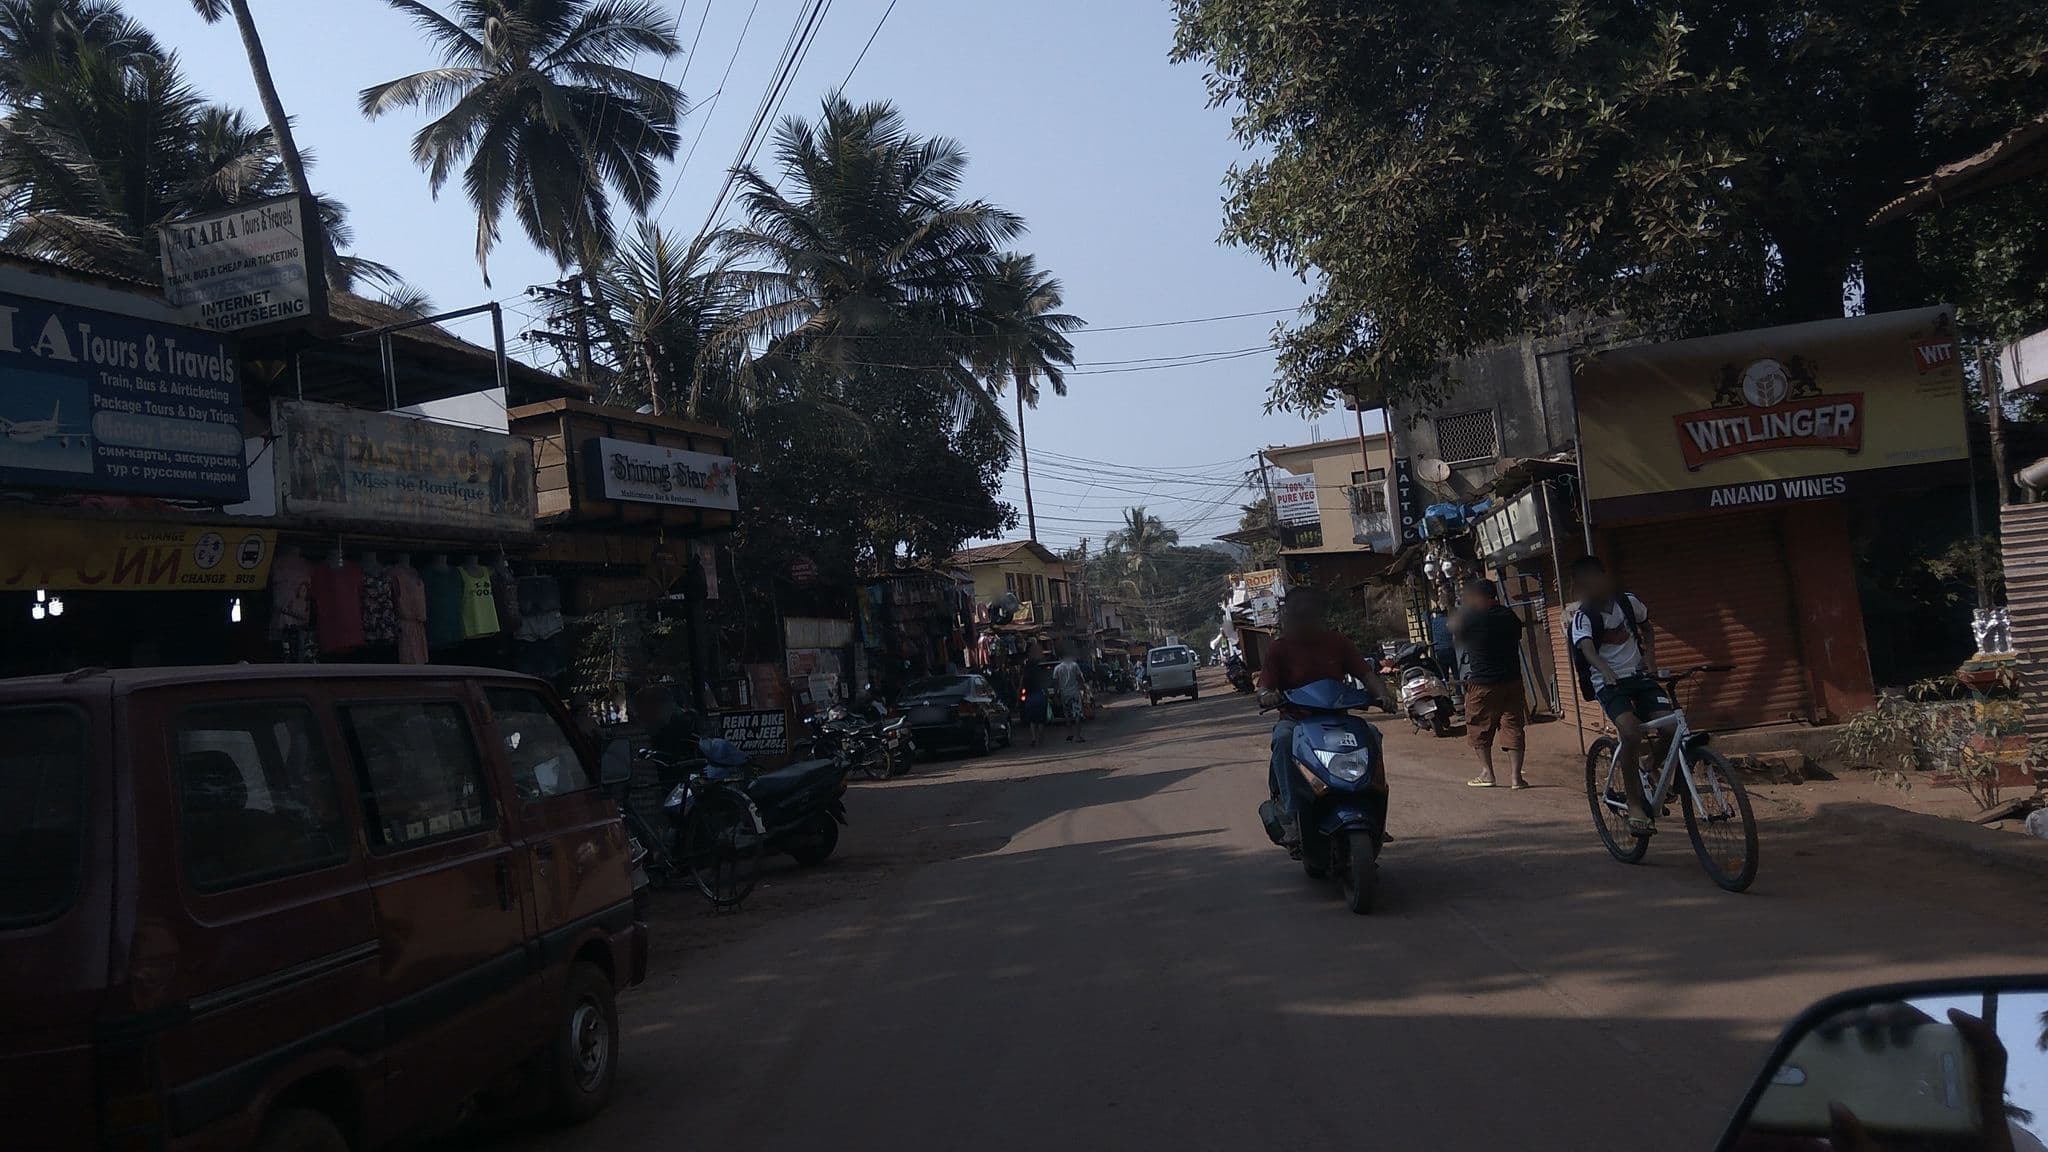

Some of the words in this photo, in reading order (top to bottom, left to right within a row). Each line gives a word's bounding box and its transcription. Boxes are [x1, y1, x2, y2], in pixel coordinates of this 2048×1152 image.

[184, 218, 237, 249] TAHA
[241, 214, 261, 236] Tours
[267, 207, 293, 229] Travels
[193, 270, 209, 281] BUS
[210, 267, 216, 277] &
[217, 262, 242, 274] CHEAP
[244, 257, 258, 268] AIR
[258, 248, 299, 265] TICKETING
[202, 290, 271, 316] INTERNET
[206, 299, 304, 329] SIGHTSEEING
[78, 322, 139, 369] Tours
[144, 334, 161, 372] &
[165, 338, 235, 384] Travels
[1918, 343, 1953, 364] WIT
[100, 372, 133, 391] Train,
[136, 377, 157, 391] Bus
[159, 380, 168, 393] &
[171, 381, 229, 404] Airticketing
[93, 393, 141, 414] Package
[144, 400, 176, 416] Tours
[178, 403, 186, 417] &
[189, 405, 208, 421] Day
[1684, 403, 1856, 454] WITLINGER
[97, 446, 172, 464] сим-карты,
[106, 463, 128, 477] тур
[143, 466, 198, 483] русским
[610, 453, 672, 492] Shining
[672, 462, 707, 489] Star
[1277, 493, 1298, 504] PURE
[1298, 491, 1315, 501] VEG
[1710, 483, 1777, 507] ANAND
[1782, 476, 1847, 499] WINES
[181, 573, 226, 584] CHANGE
[234, 574, 256, 584] BUS
[723, 715, 751, 728] RENT
[752, 715, 759, 727] A
[761, 713, 785, 726] BIKE
[724, 728, 747, 740] CAR
[747, 730, 754, 738] &
[756, 726, 785, 739] JEEP
